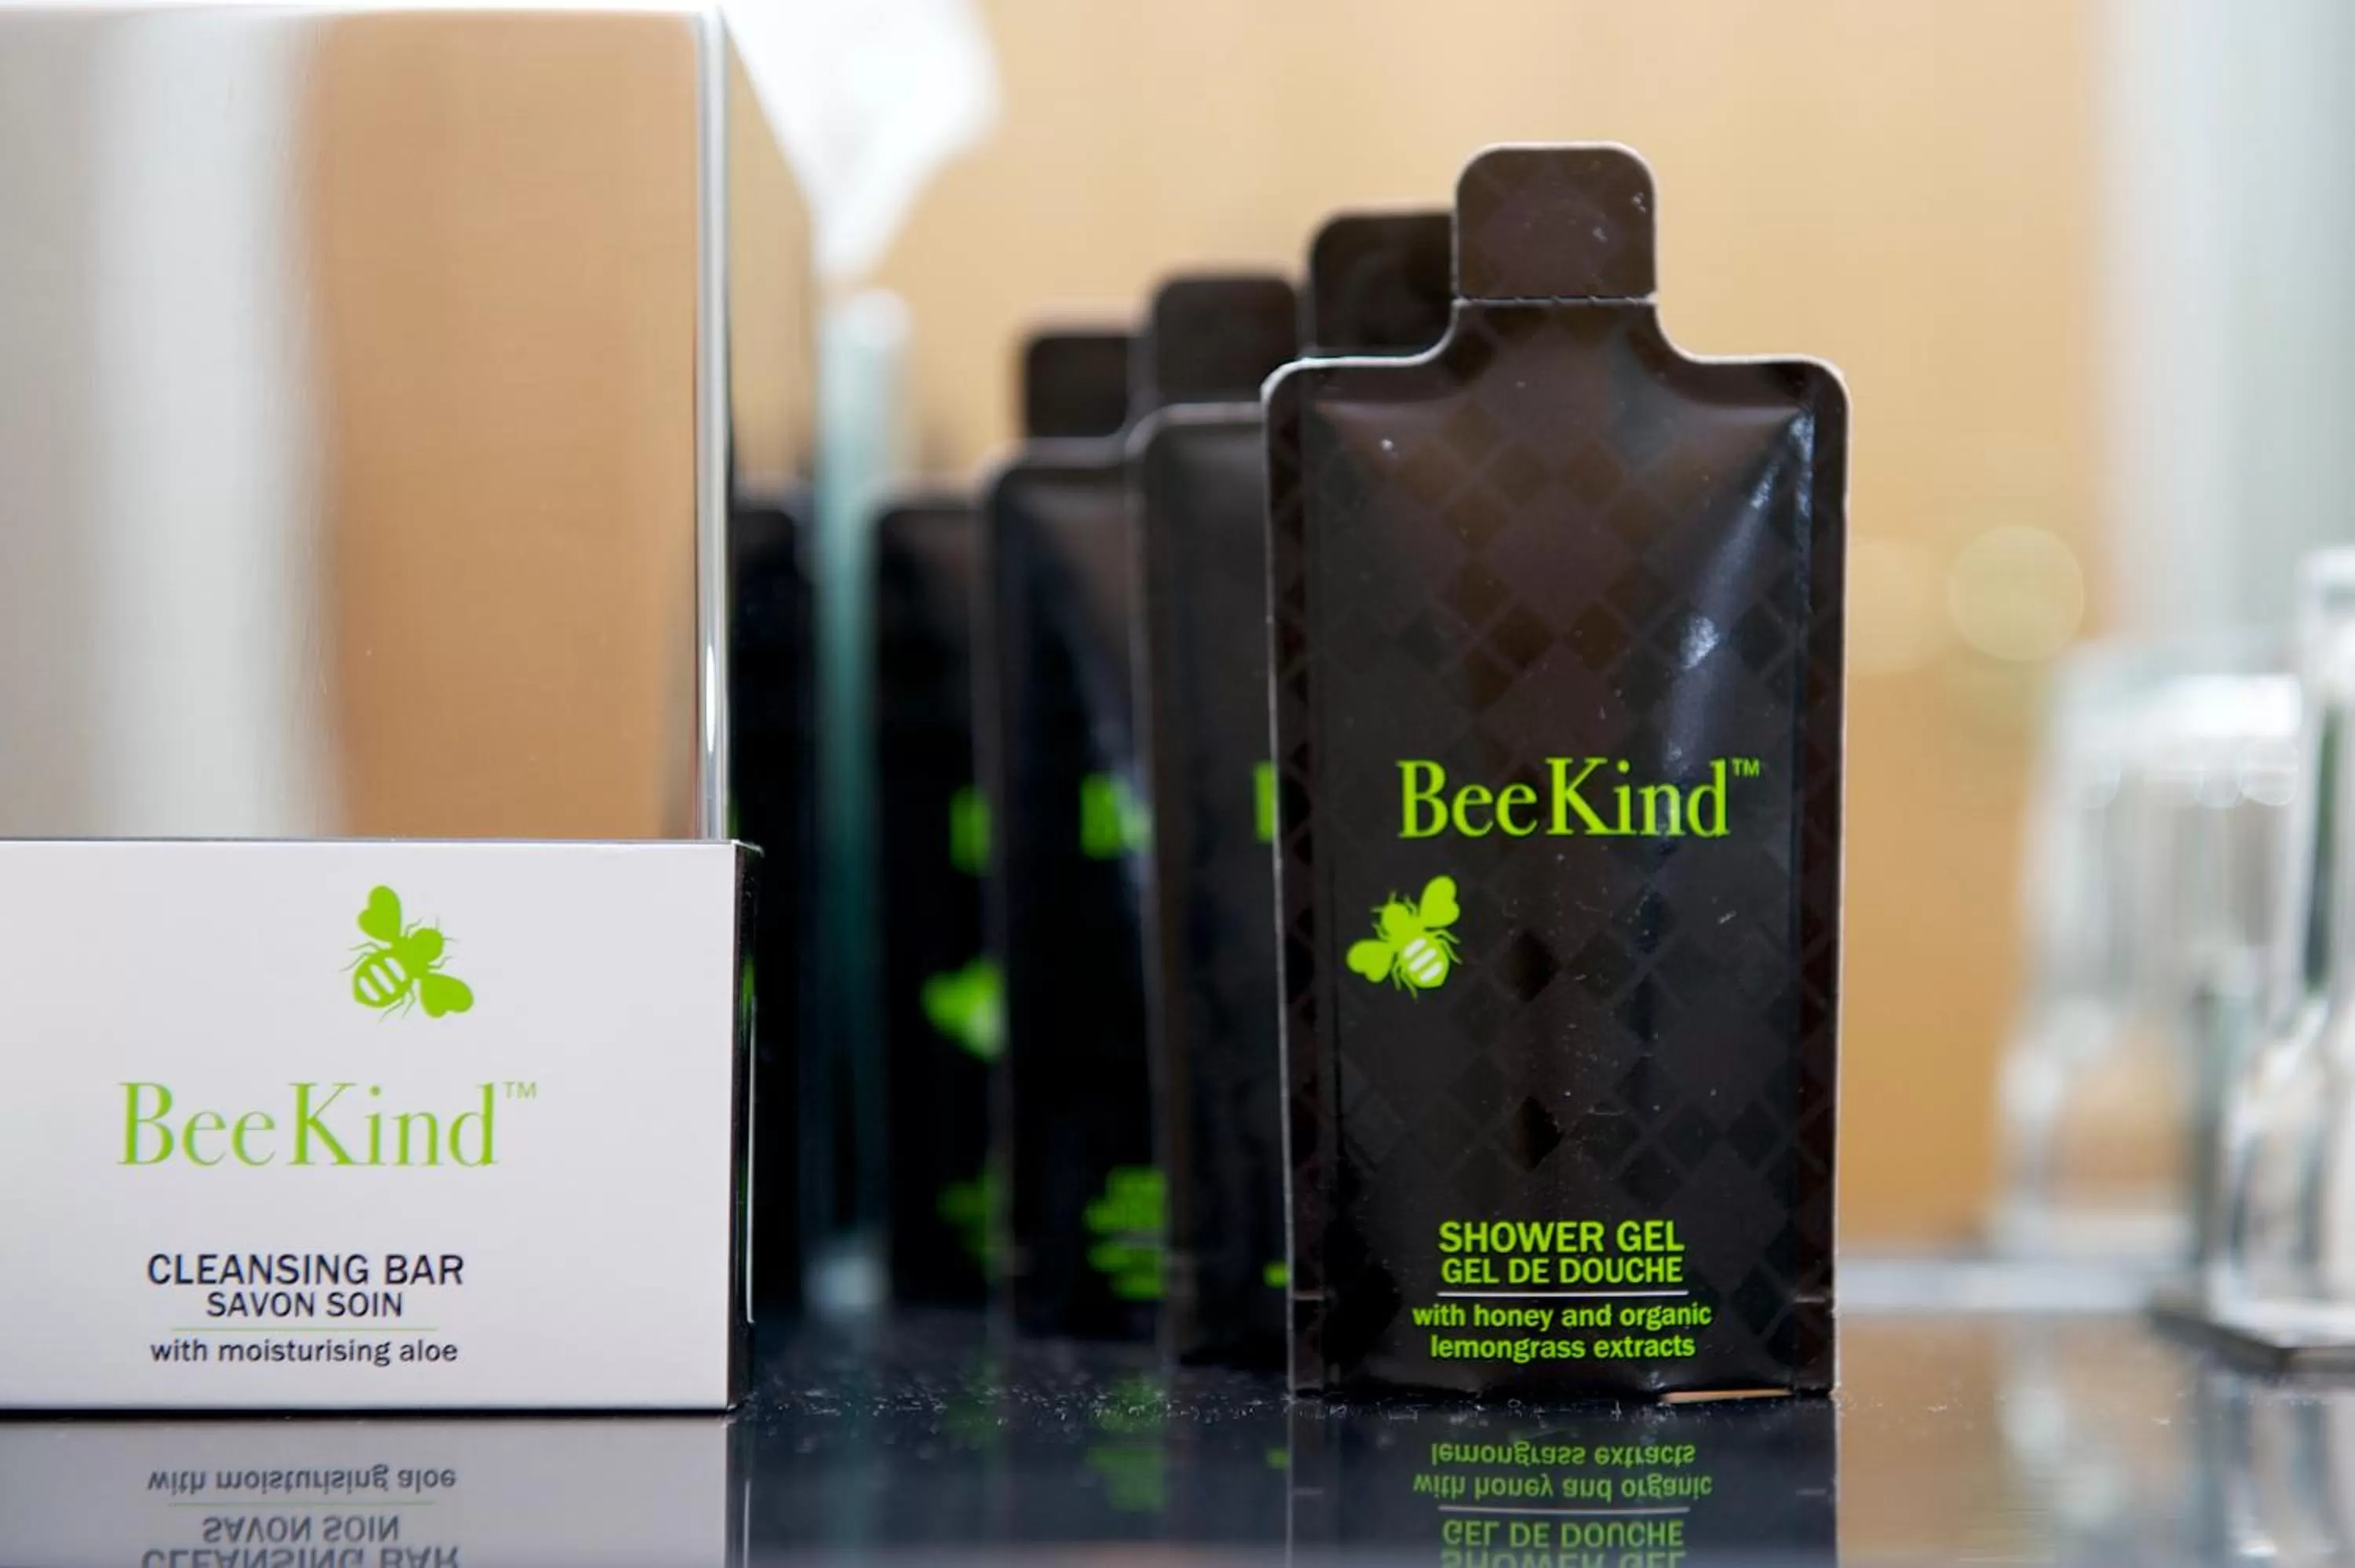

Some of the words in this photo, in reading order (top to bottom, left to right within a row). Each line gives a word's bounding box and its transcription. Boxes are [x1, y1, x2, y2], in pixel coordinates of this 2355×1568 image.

[1439, 1220, 1605, 1253] SHOWER
[1616, 1220, 1684, 1253] GEL
[148, 1253, 368, 1285] CLEANSING
[385, 1254, 464, 1285] BAR
[1440, 1256, 1500, 1284] GEL
[1508, 1257, 1549, 1284] DE
[1560, 1256, 1682, 1284] DOUCHE
[207, 1291, 315, 1318] SAVON
[327, 1291, 402, 1318] SOIN
[1412, 1304, 1466, 1326] with
[1473, 1305, 1554, 1332] honey
[1561, 1303, 1612, 1327] and
[1619, 1304, 1711, 1332] organic
[150, 1339, 208, 1362] with
[218, 1339, 391, 1367] moisturising
[400, 1340, 458, 1362] aloe
[1430, 1333, 1586, 1364] lemongrass
[1593, 1334, 1696, 1358] extracts
